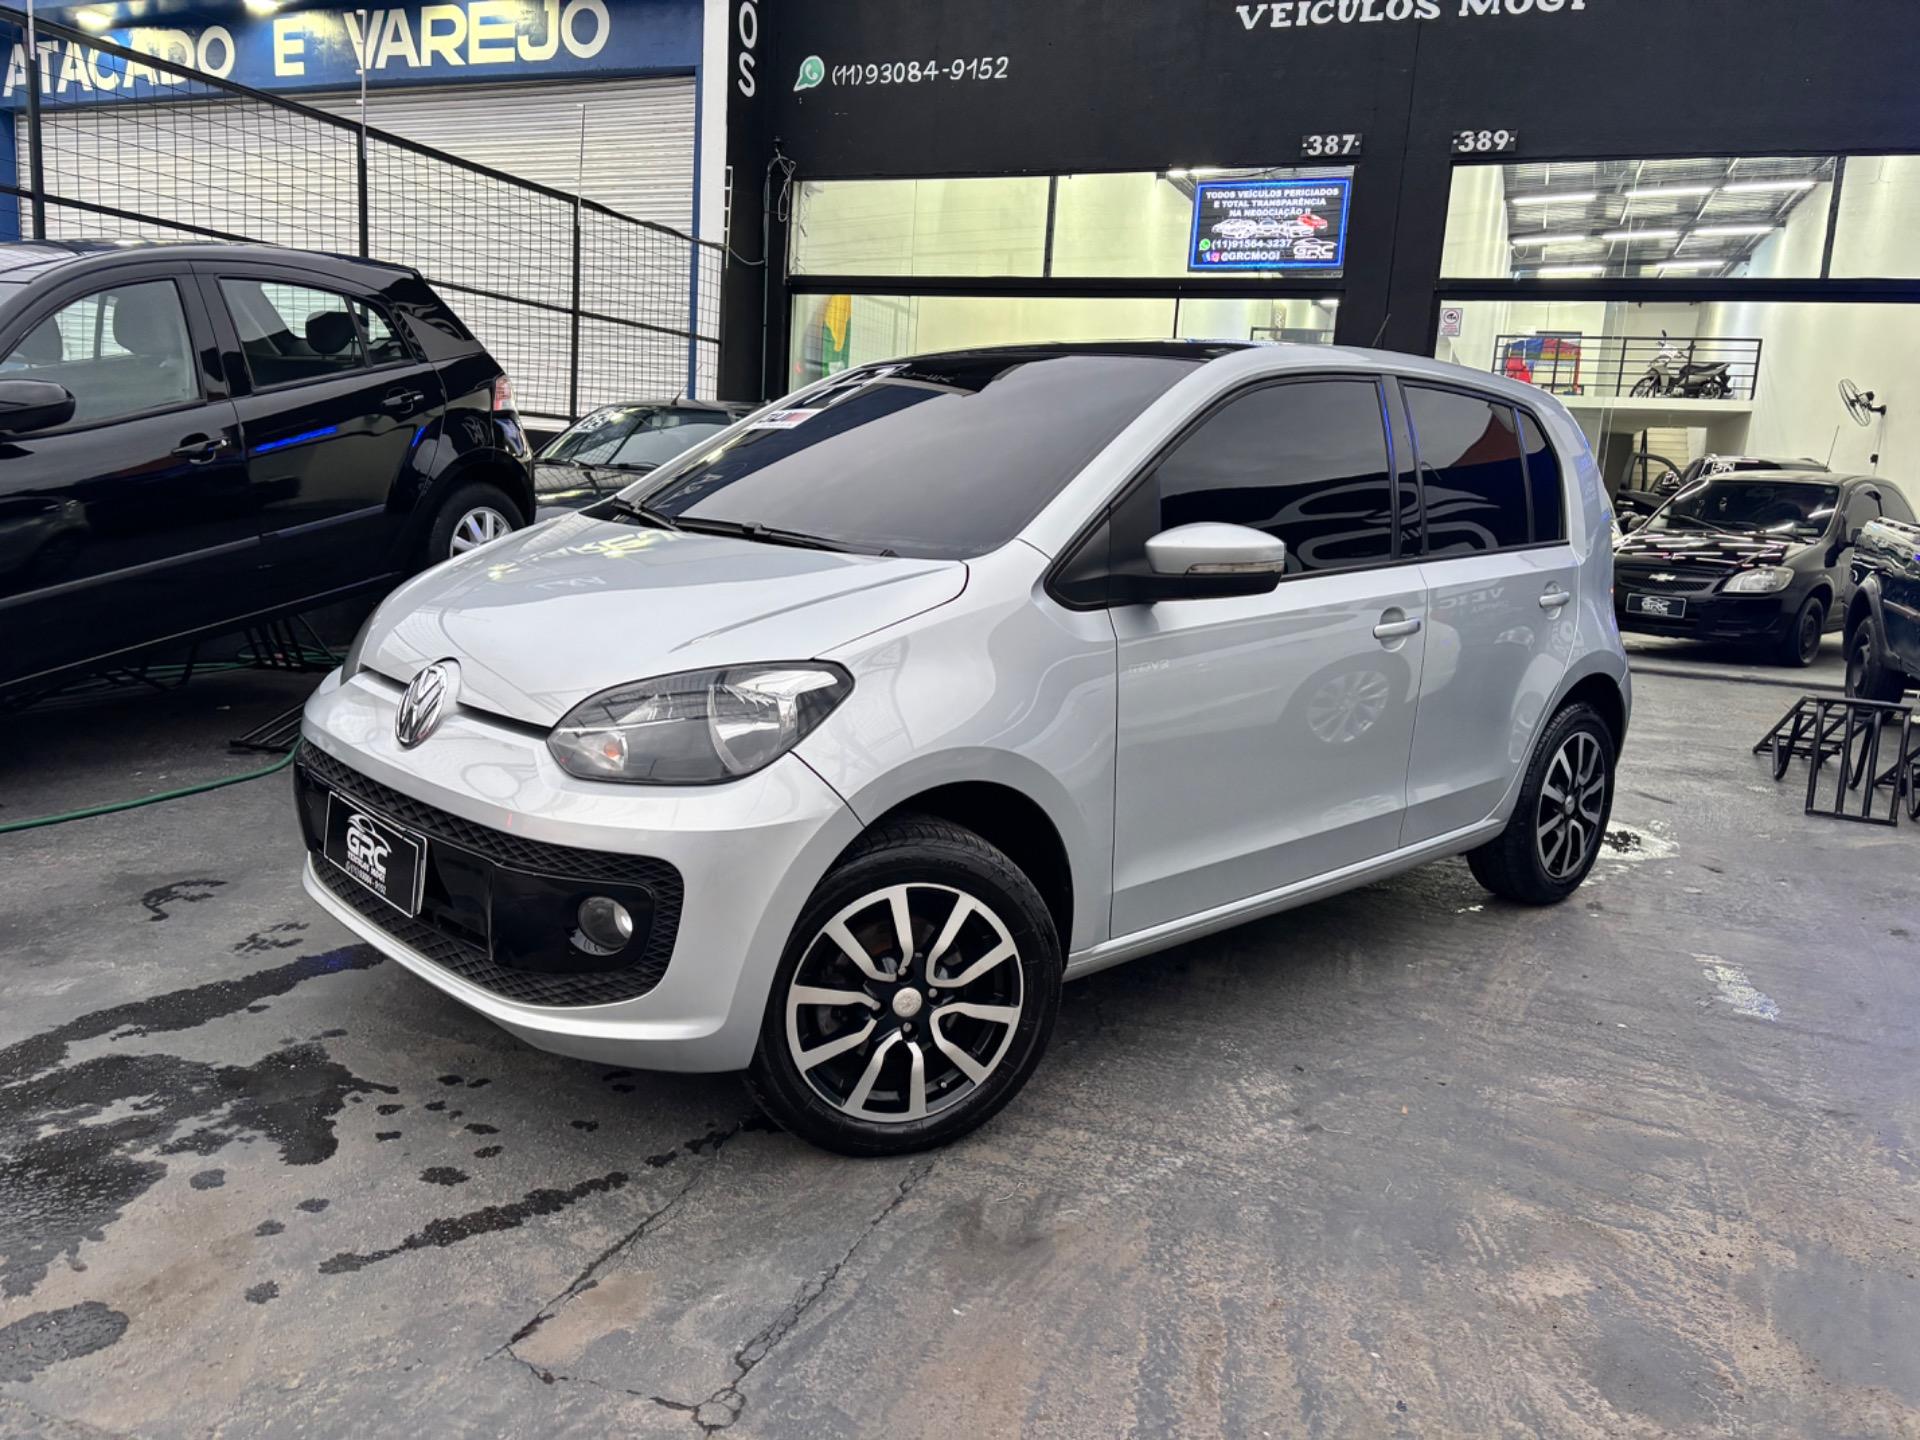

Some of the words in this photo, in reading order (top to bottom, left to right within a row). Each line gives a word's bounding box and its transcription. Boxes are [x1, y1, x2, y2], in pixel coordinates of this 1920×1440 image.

[1236, 0, 1441, 30] VEICULOS
[3, 25, 235, 97] ATACADO
[273, 18, 305, 77] E
[343, 0, 611, 70] VAREJO
[738, 0, 758, 97] OS
[832, 56, 1009, 86] (11)93084-9152
[1306, 134, 1356, 156] 387
[1457, 129, 1509, 152] 389
[1206, 191, 1236, 199] TODOS
[1283, 187, 1339, 197] PERICIADOS
[1213, 200, 1220, 208] E
[1222, 199, 1250, 208] TOTAL
[1229, 209, 1242, 217] NA
[1221, 250, 1281, 261] @GRCMOGI
[1293, 245, 1335, 256] GRC
[347, 826, 388, 875] GRC
